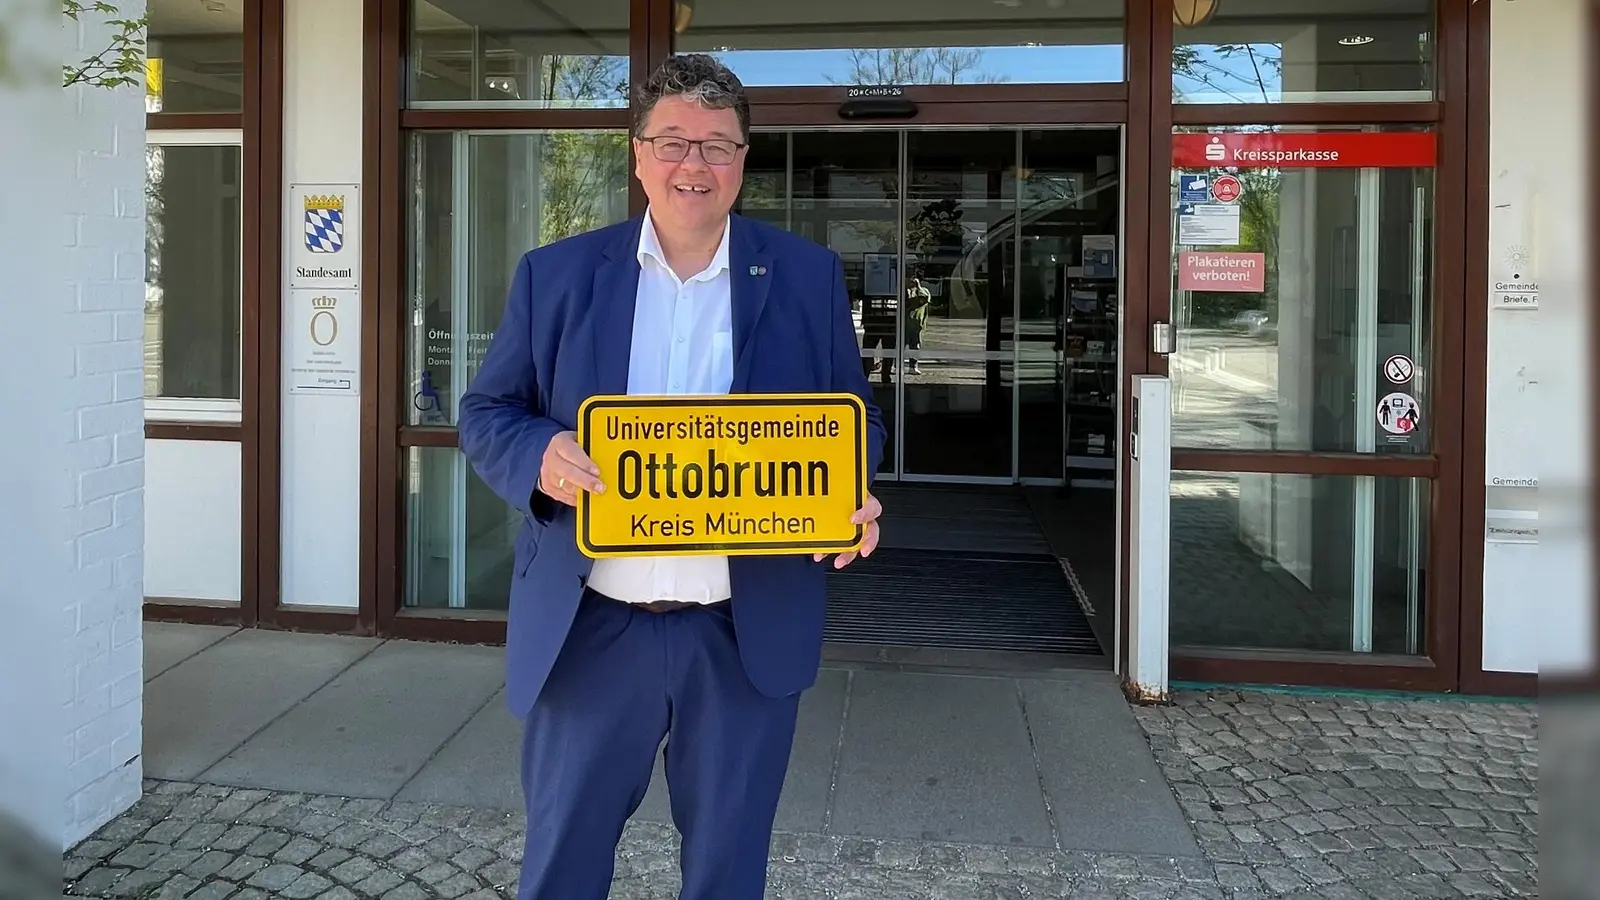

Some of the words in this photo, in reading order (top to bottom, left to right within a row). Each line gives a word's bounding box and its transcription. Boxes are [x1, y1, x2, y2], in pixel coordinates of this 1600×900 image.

[1233, 148, 1339, 163] Kreissparkasse
[1187, 255, 1256, 268] Plakatieren
[296, 266, 352, 278] Standesamt
[1192, 269, 1250, 281] verboten!
[606, 414, 840, 445] Universitätsgemeinde
[617, 449, 830, 500] Ottobrunn
[631, 513, 695, 538] Kreis
[705, 511, 816, 536] München
